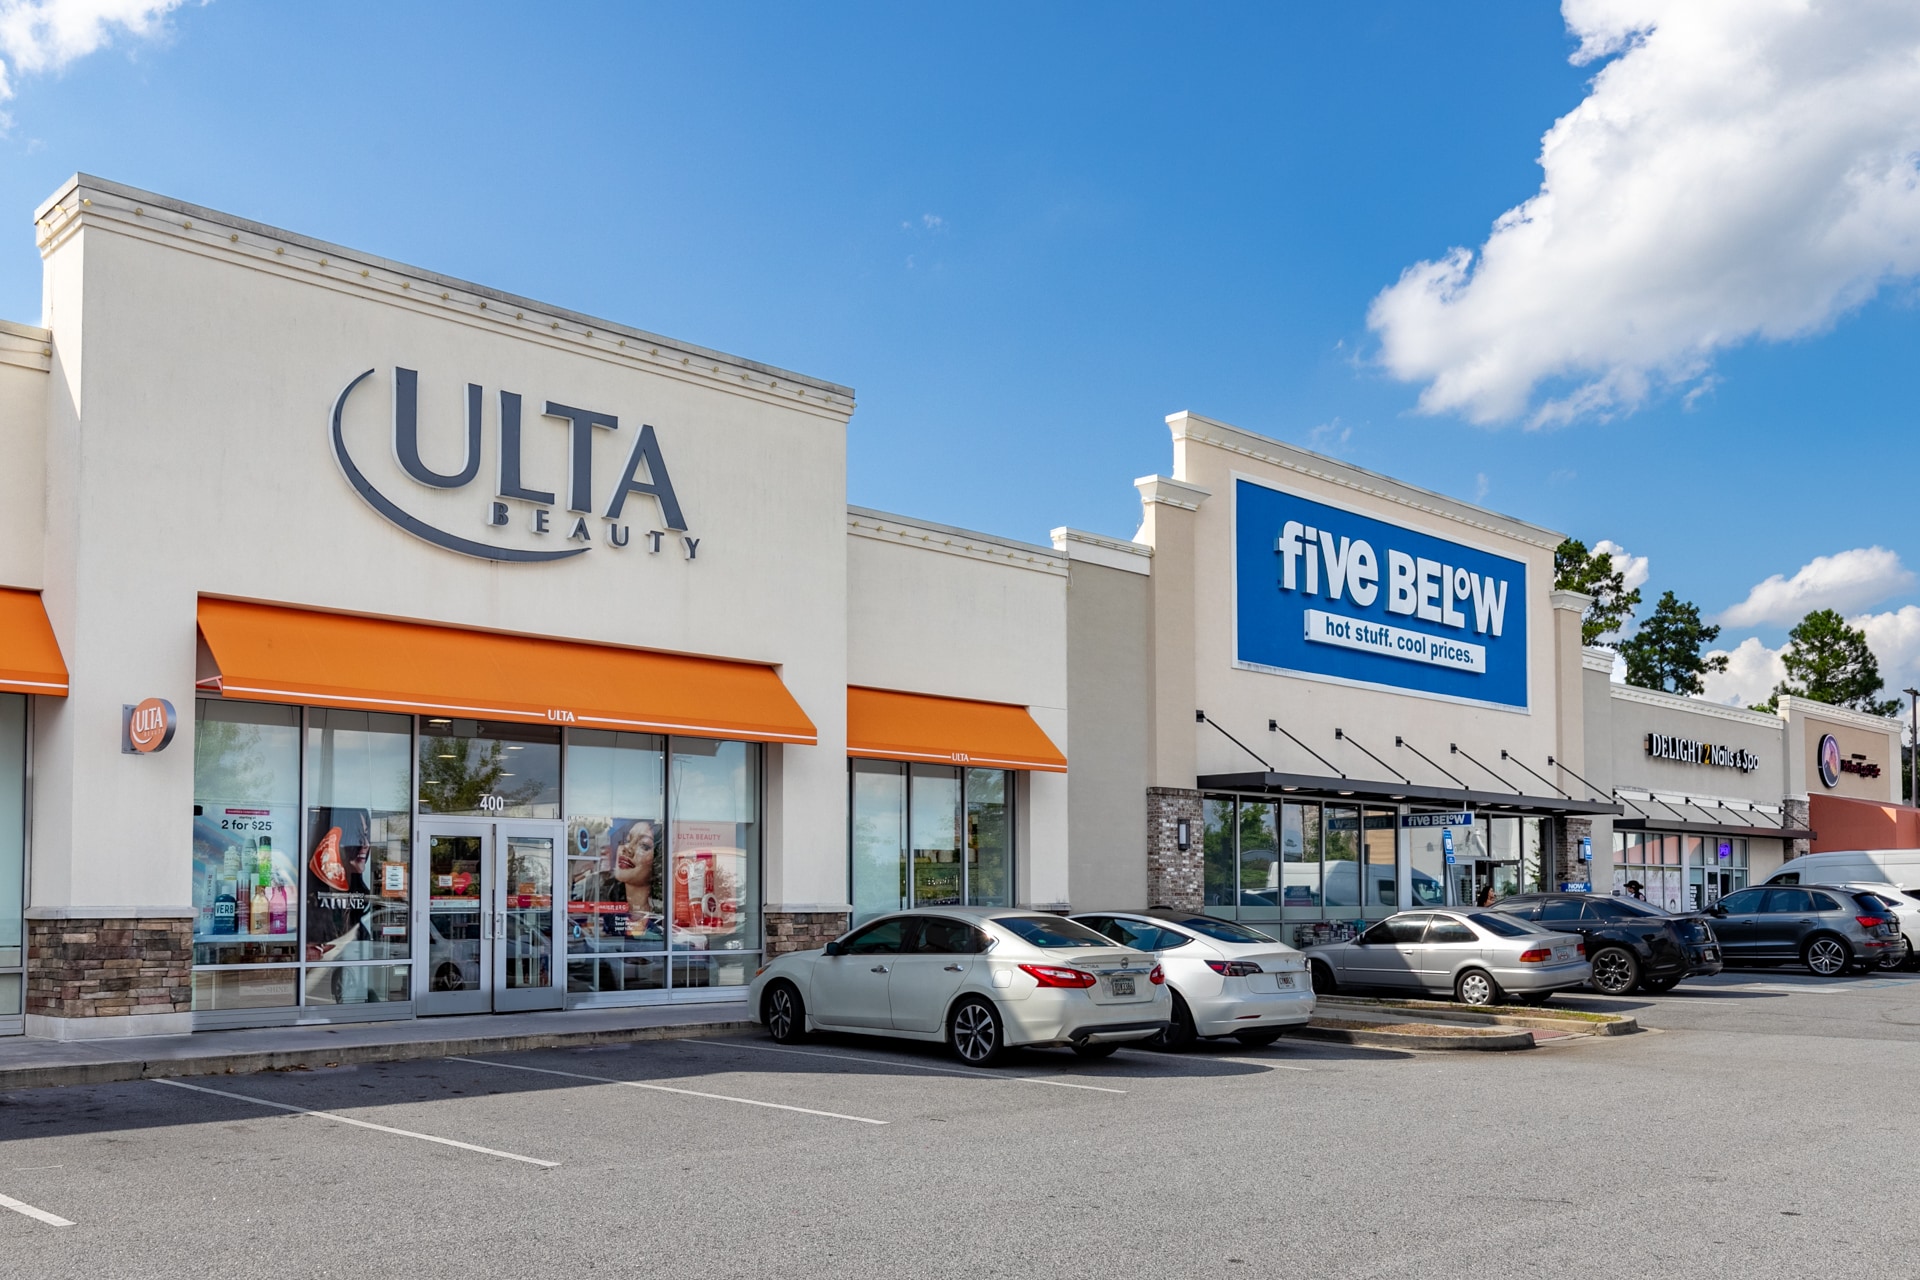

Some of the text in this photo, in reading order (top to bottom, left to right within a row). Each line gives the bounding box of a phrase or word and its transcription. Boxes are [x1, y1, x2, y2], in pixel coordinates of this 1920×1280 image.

[391, 366, 688, 532] ULTA
[488, 501, 700, 560] BEAUTY
[1275, 520, 1379, 607] five
[1325, 616, 1474, 664] hot stuff. cool prices.
[136, 706, 163, 733] ULTA
[547, 709, 575, 722] ULTA
[951, 752, 969, 762] ULTA
[1650, 733, 1760, 772] DELIGHT 2 Nails & Spa
[480, 796, 504, 810] 400
[221, 820, 229, 829] 2
[232, 819, 249, 830] for
[1408, 815, 1430, 826] five
[695, 833, 721, 841] BEAUTY
[216, 904, 234, 914] VERB
